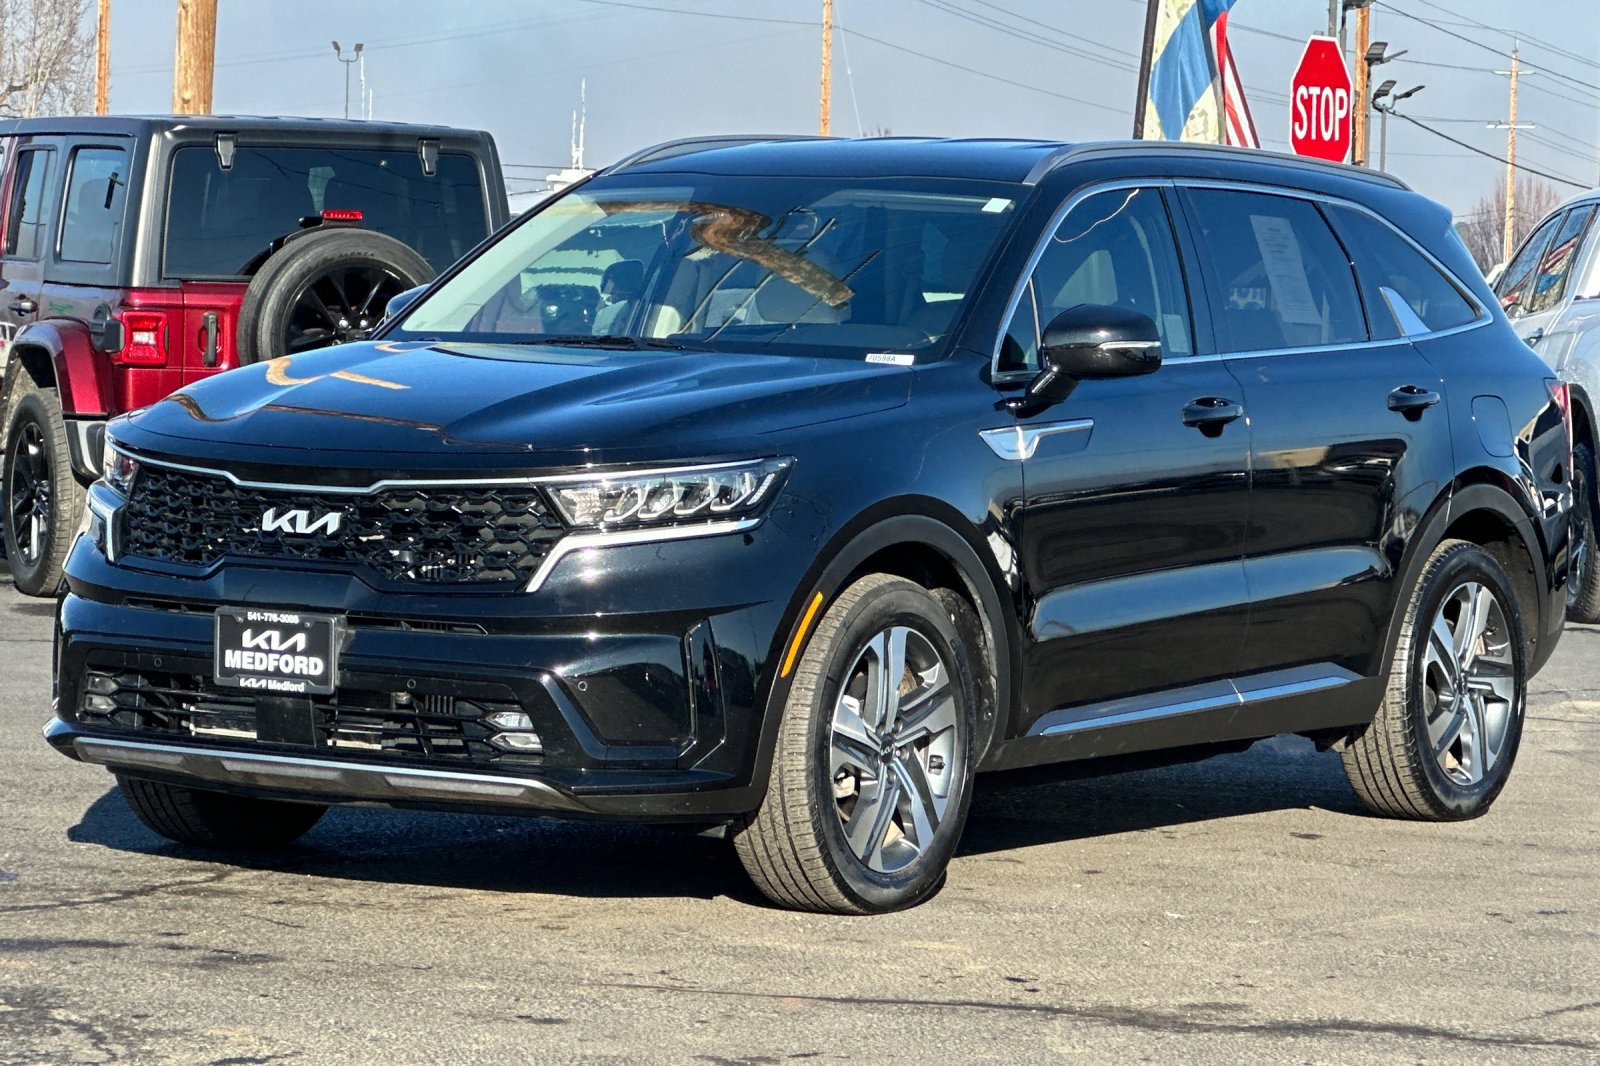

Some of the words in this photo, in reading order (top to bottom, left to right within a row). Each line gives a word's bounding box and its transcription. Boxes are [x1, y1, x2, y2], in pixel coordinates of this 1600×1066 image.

[1295, 85, 1348, 141] STOP
[262, 507, 341, 536] KIA
[242, 628, 306, 652] KIA
[225, 649, 324, 676] MEDFORD
[239, 677, 267, 689] KIA
[268, 679, 305, 692] Medford
